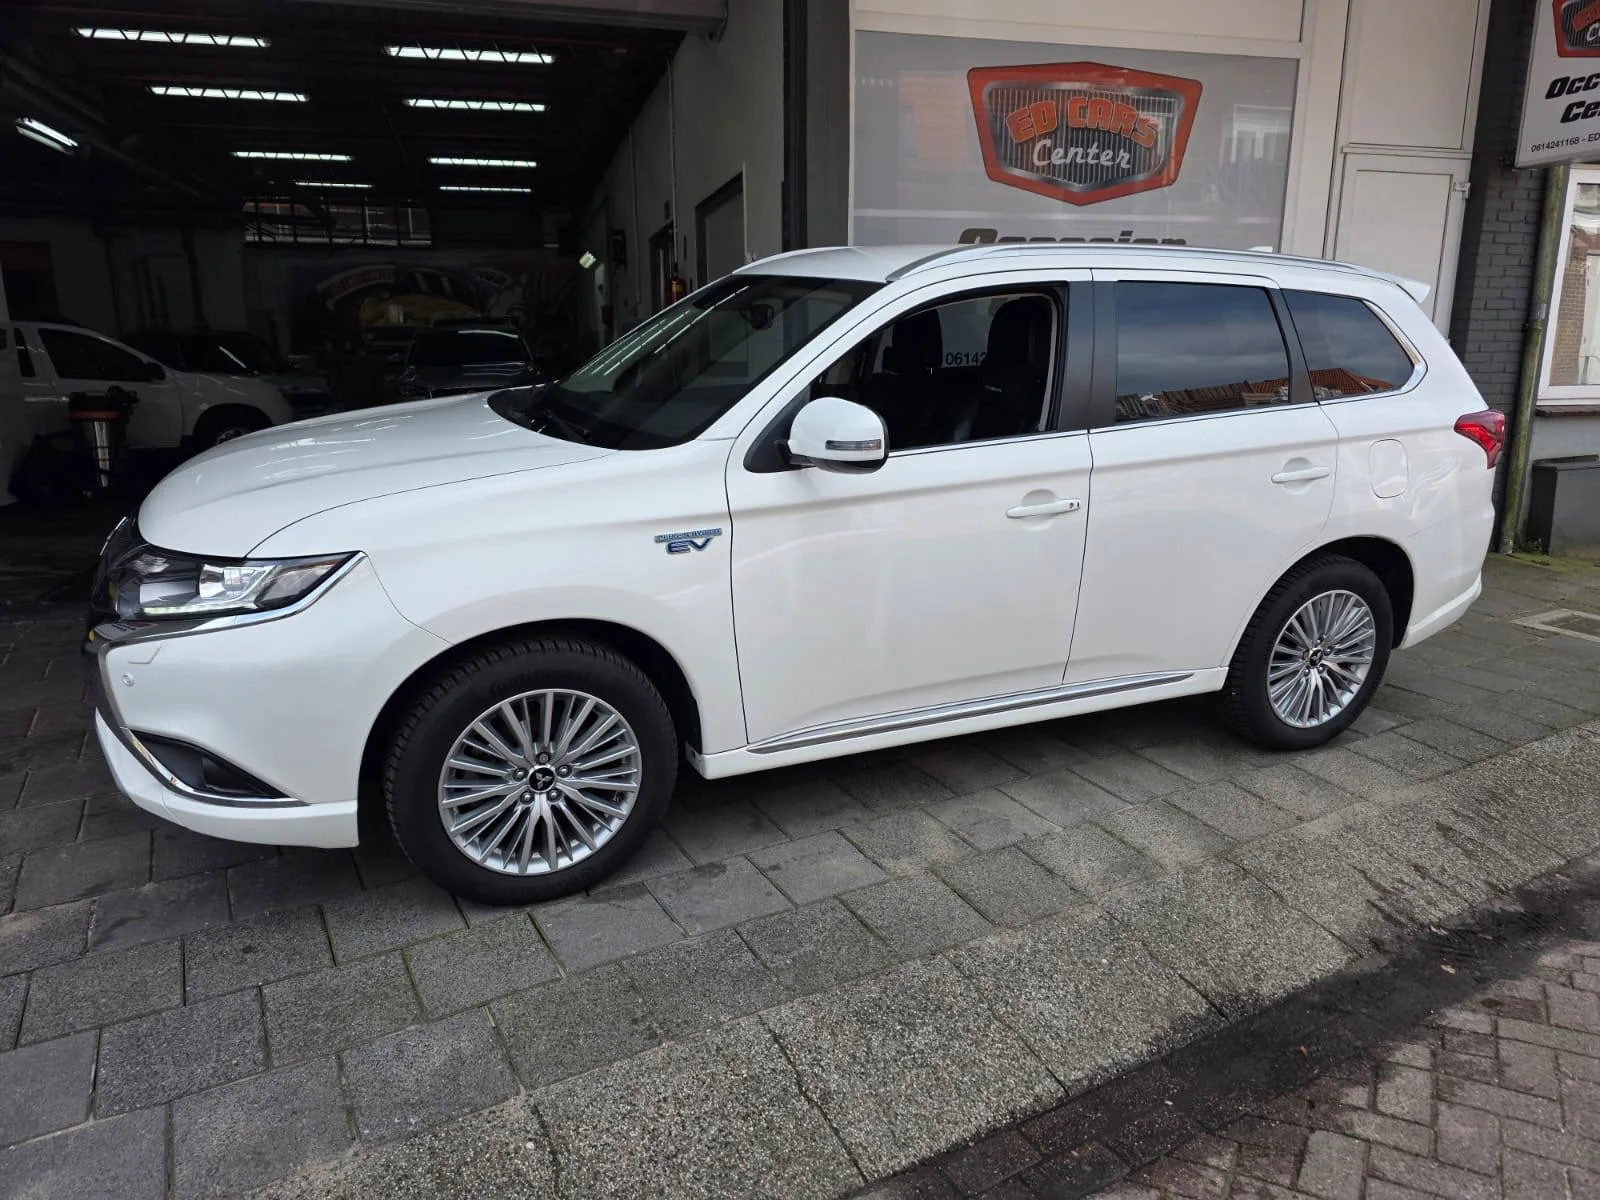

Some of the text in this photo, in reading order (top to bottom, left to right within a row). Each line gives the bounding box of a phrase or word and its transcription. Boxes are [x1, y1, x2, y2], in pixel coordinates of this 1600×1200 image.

[1006, 96, 1160, 148] ED CARS
[1033, 138, 1131, 169] Center
[1531, 136, 1580, 153] 0614241168
[665, 537, 714, 555] EV
